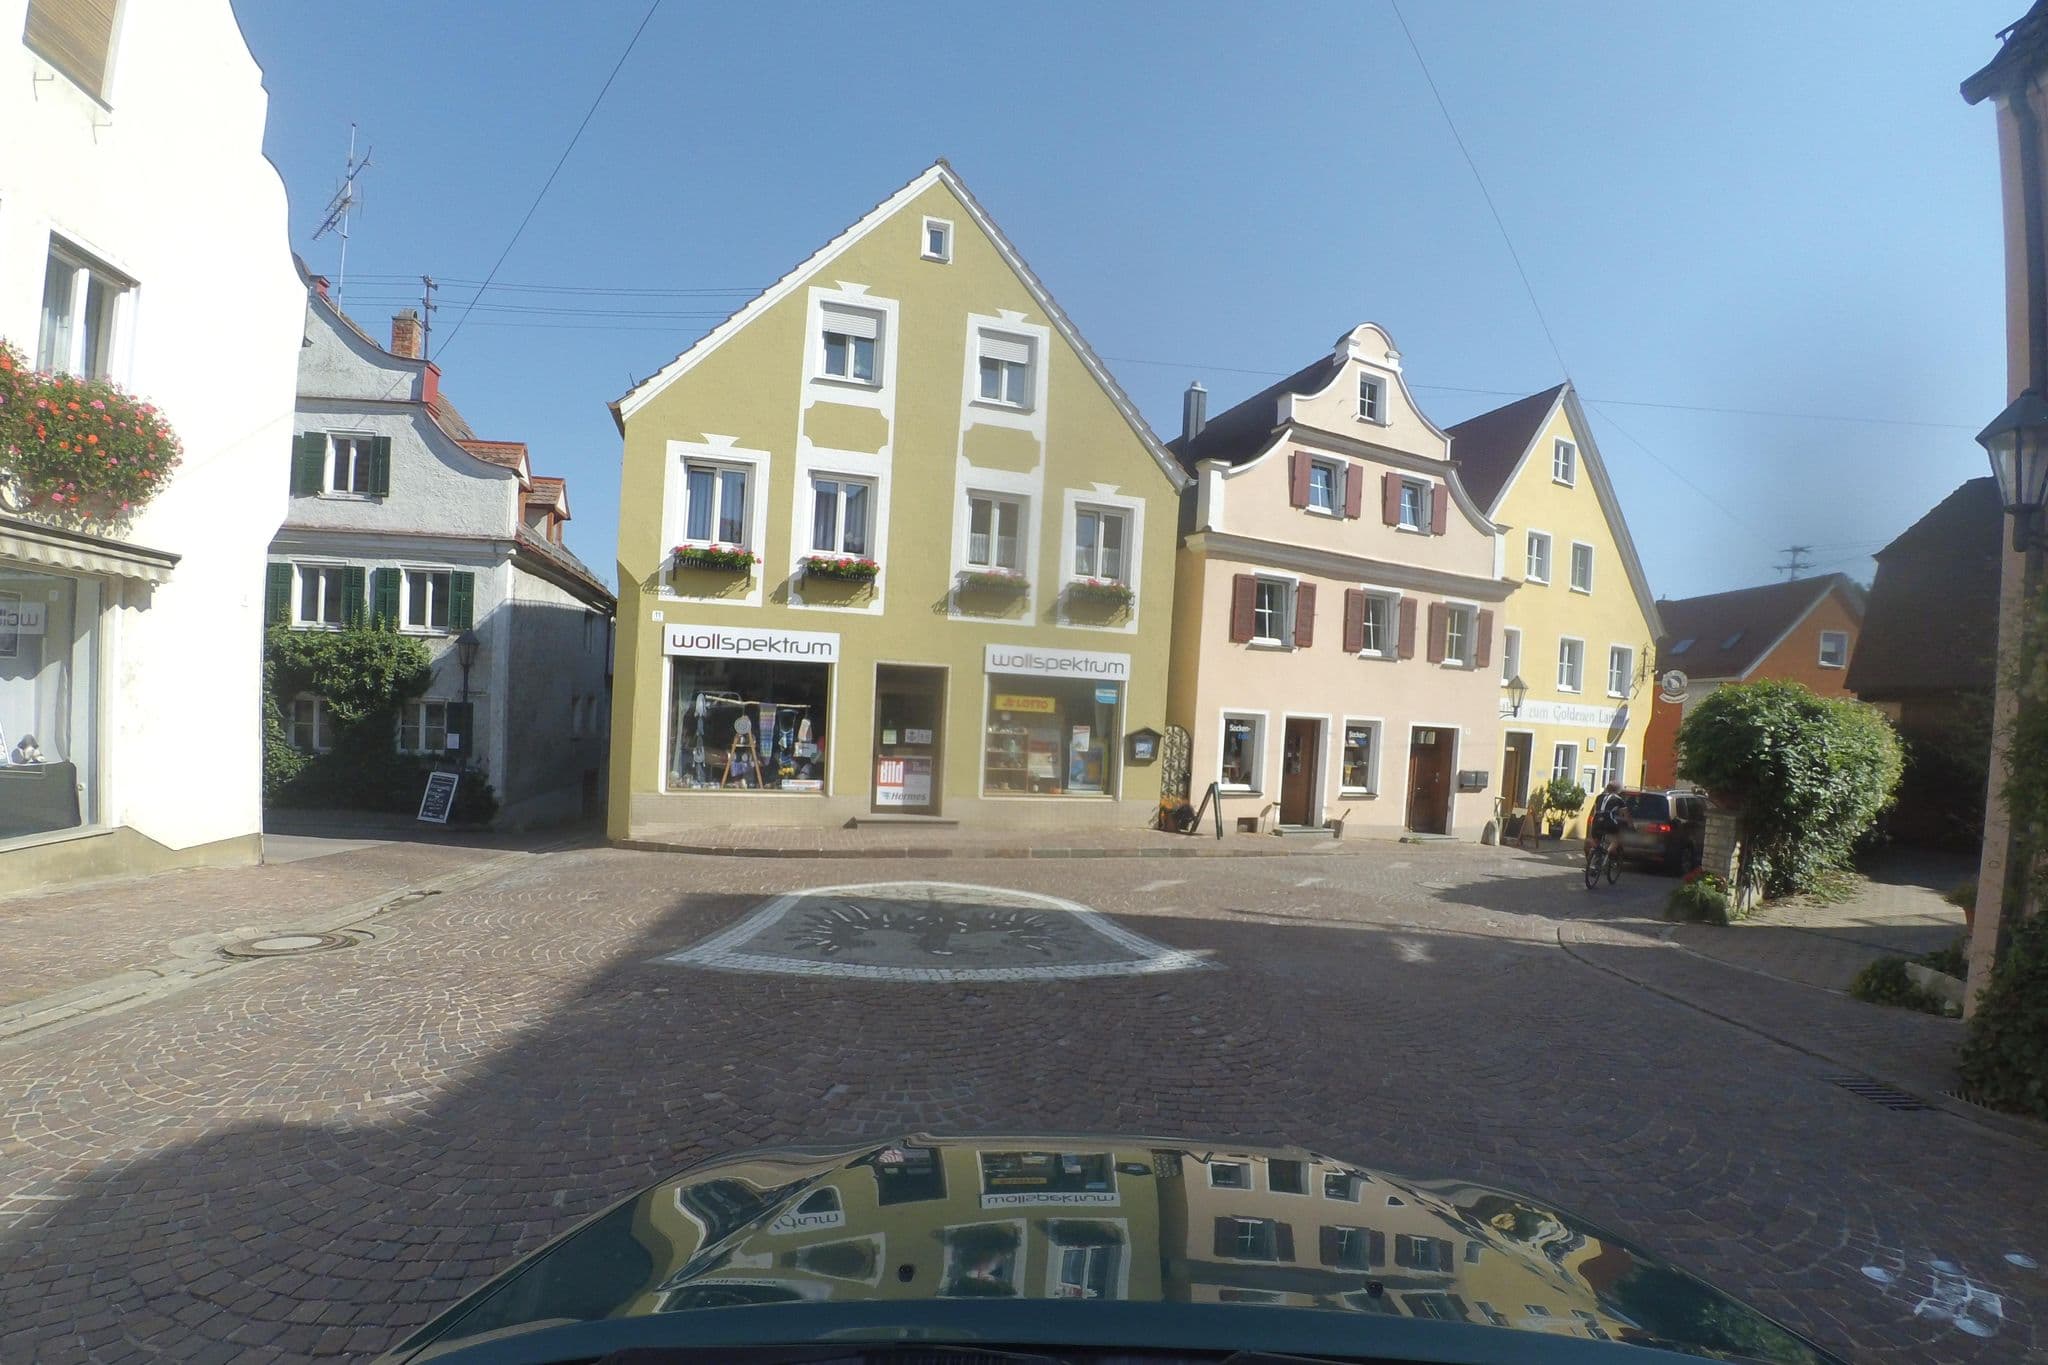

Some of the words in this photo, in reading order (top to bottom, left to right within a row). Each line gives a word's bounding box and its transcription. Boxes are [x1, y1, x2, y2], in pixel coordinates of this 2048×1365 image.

[672, 633, 832, 655] wollspektrum
[992, 653, 1125, 675] wollspektrum
[880, 761, 904, 784] Bild
[891, 792, 928, 801] Hermes
